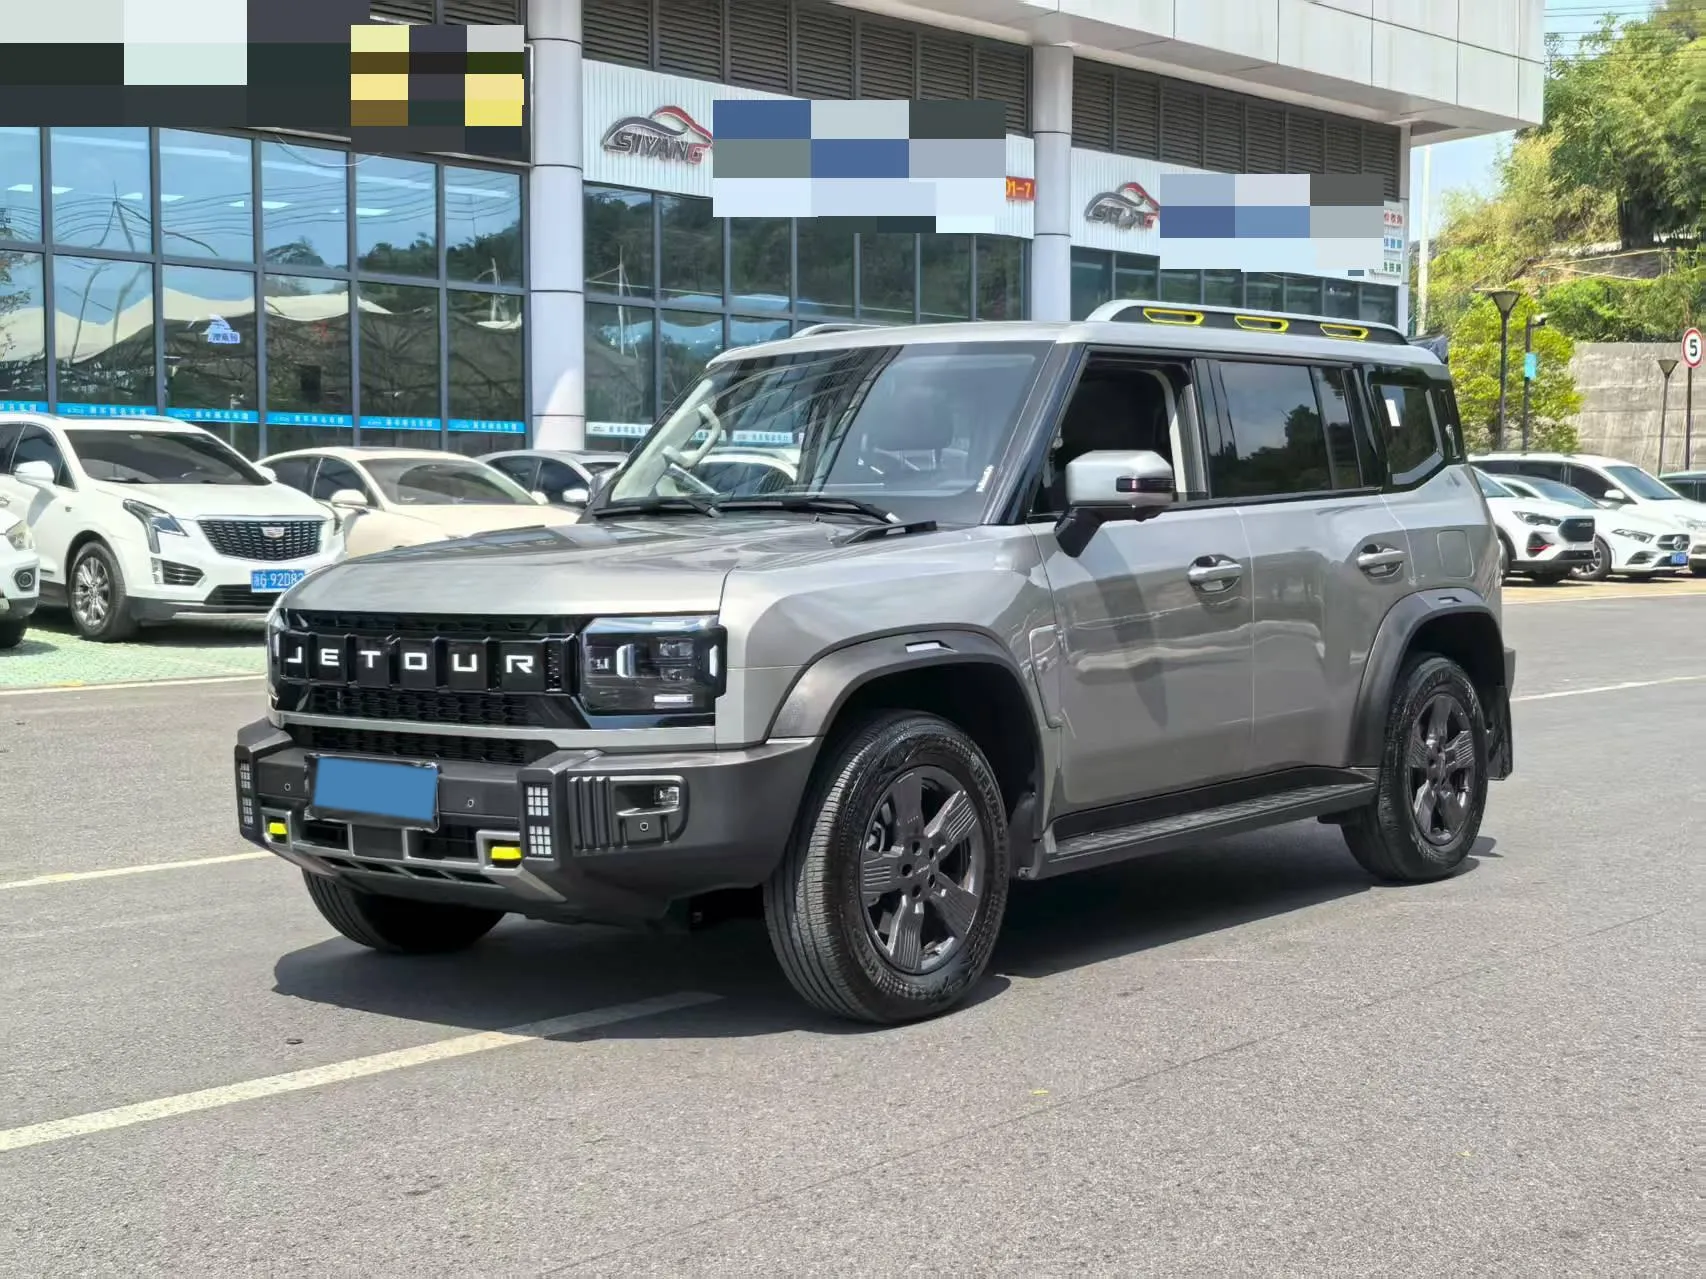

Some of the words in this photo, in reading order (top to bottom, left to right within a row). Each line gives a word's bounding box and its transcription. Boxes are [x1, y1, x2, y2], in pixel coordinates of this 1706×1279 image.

[603, 131, 713, 165] SIYANG
[1689, 338, 1698, 357] 5
[286, 646, 535, 674] JETOUR
